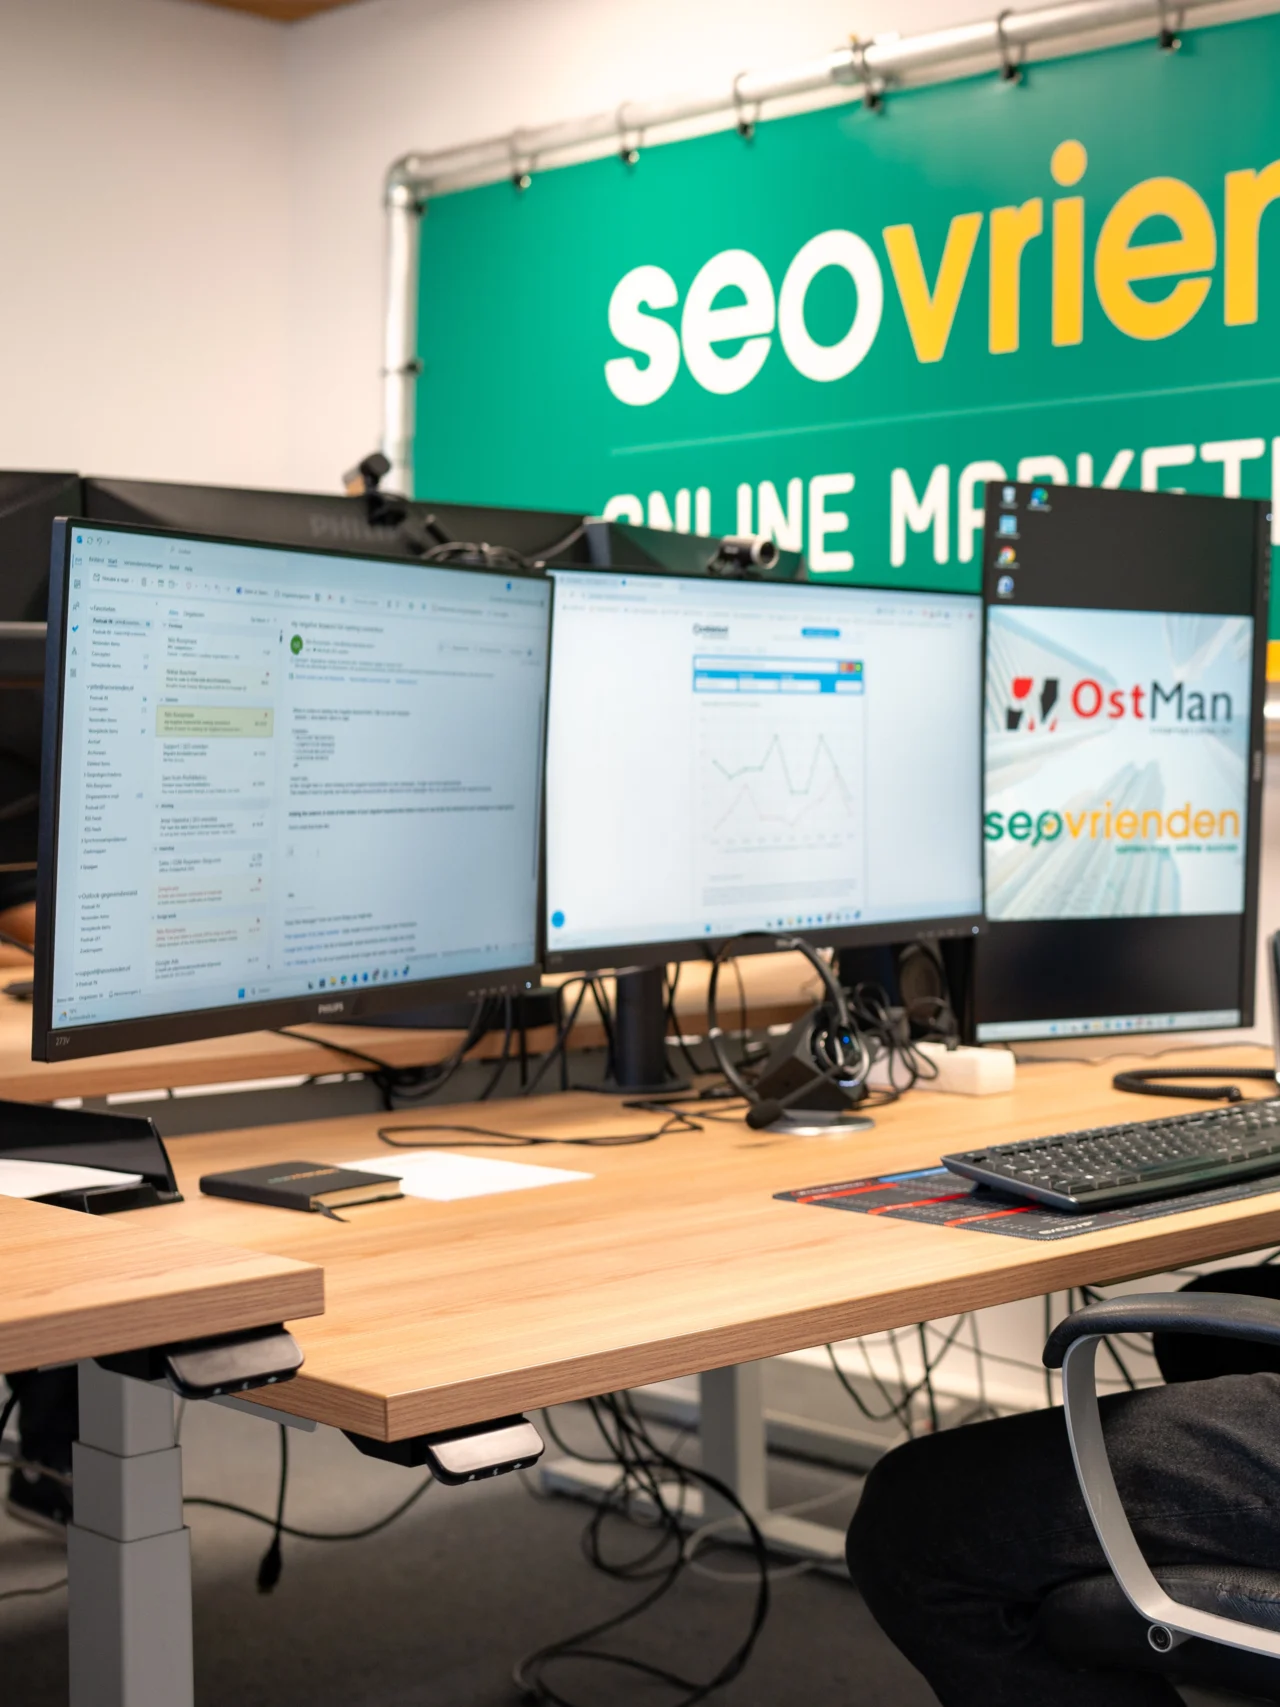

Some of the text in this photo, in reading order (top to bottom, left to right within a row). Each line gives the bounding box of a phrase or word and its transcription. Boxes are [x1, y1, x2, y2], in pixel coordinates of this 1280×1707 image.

[1070, 677, 1234, 723] OstMan
[983, 800, 1241, 848] seovrienden
[55, 1035, 71, 1047] 273V
